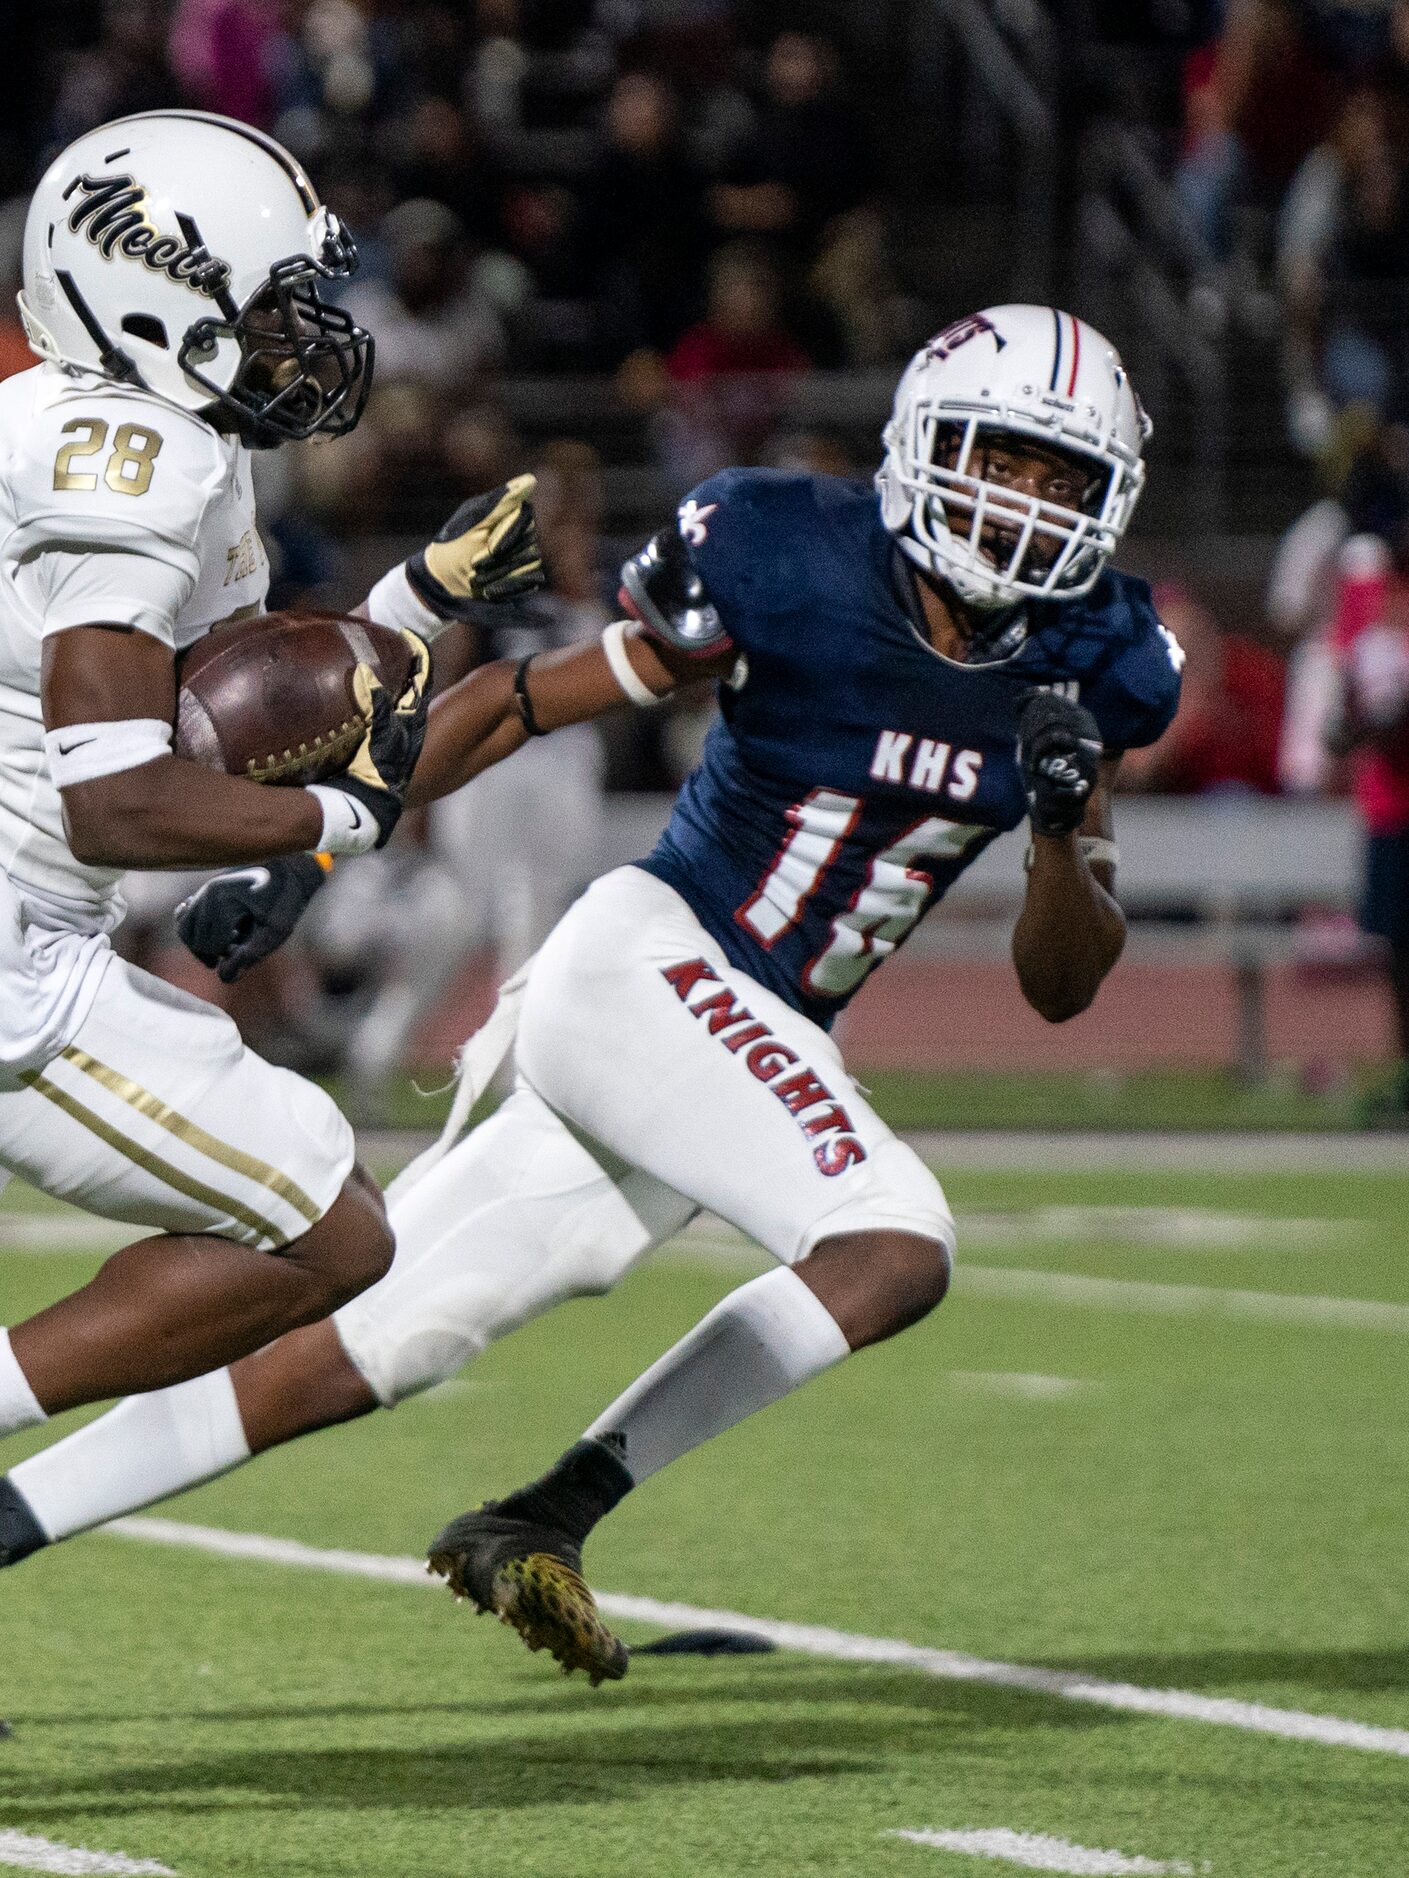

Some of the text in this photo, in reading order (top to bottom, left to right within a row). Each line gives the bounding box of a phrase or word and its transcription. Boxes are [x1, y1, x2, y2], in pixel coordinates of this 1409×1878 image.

[52, 416, 164, 497] 28
[869, 729, 984, 801] KHS
[733, 786, 994, 998] 16
[659, 956, 869, 1178] KNIGHTS
